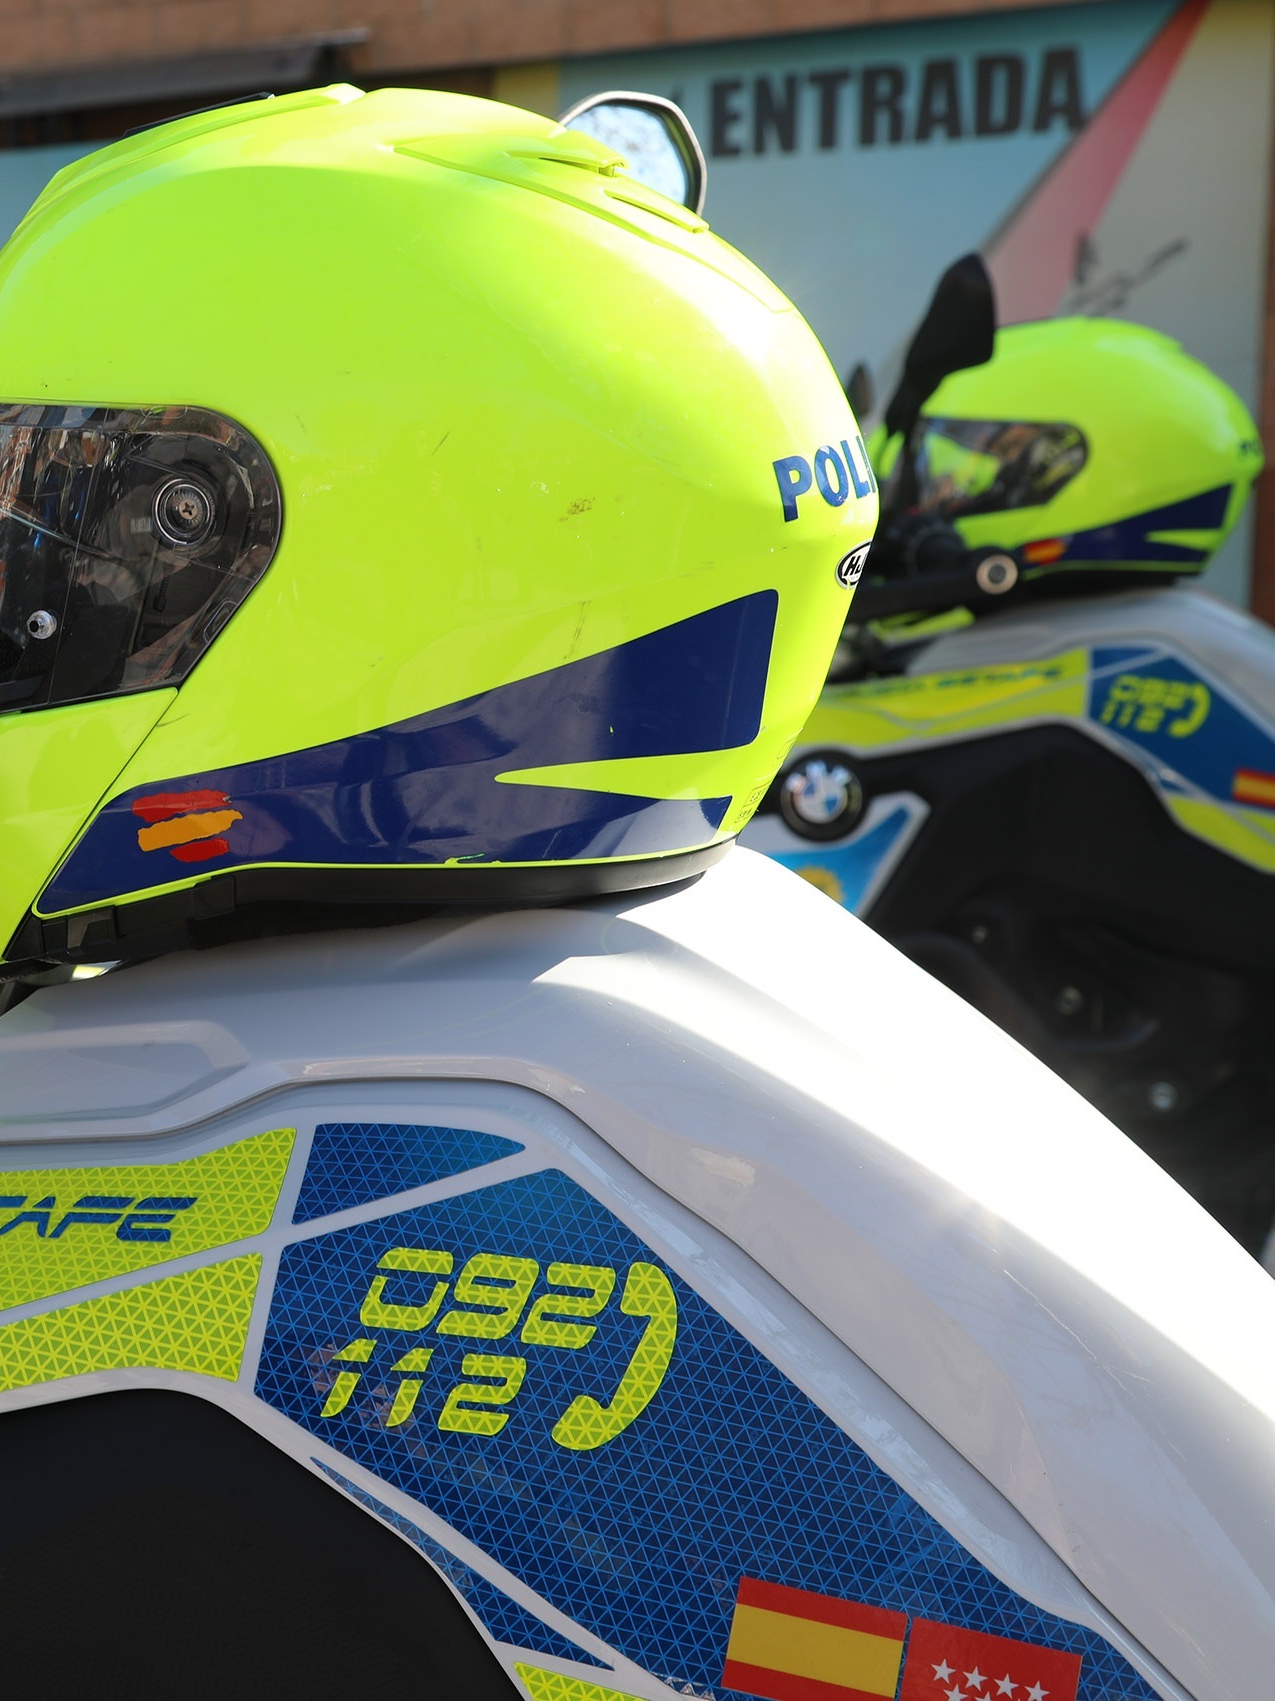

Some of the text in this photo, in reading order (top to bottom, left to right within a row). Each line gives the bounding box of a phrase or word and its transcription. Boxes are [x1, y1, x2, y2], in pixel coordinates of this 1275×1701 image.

[710, 46, 1088, 158] ENTRADA
[359, 1247, 617, 1350] 092
[320, 1338, 527, 1436] 112
